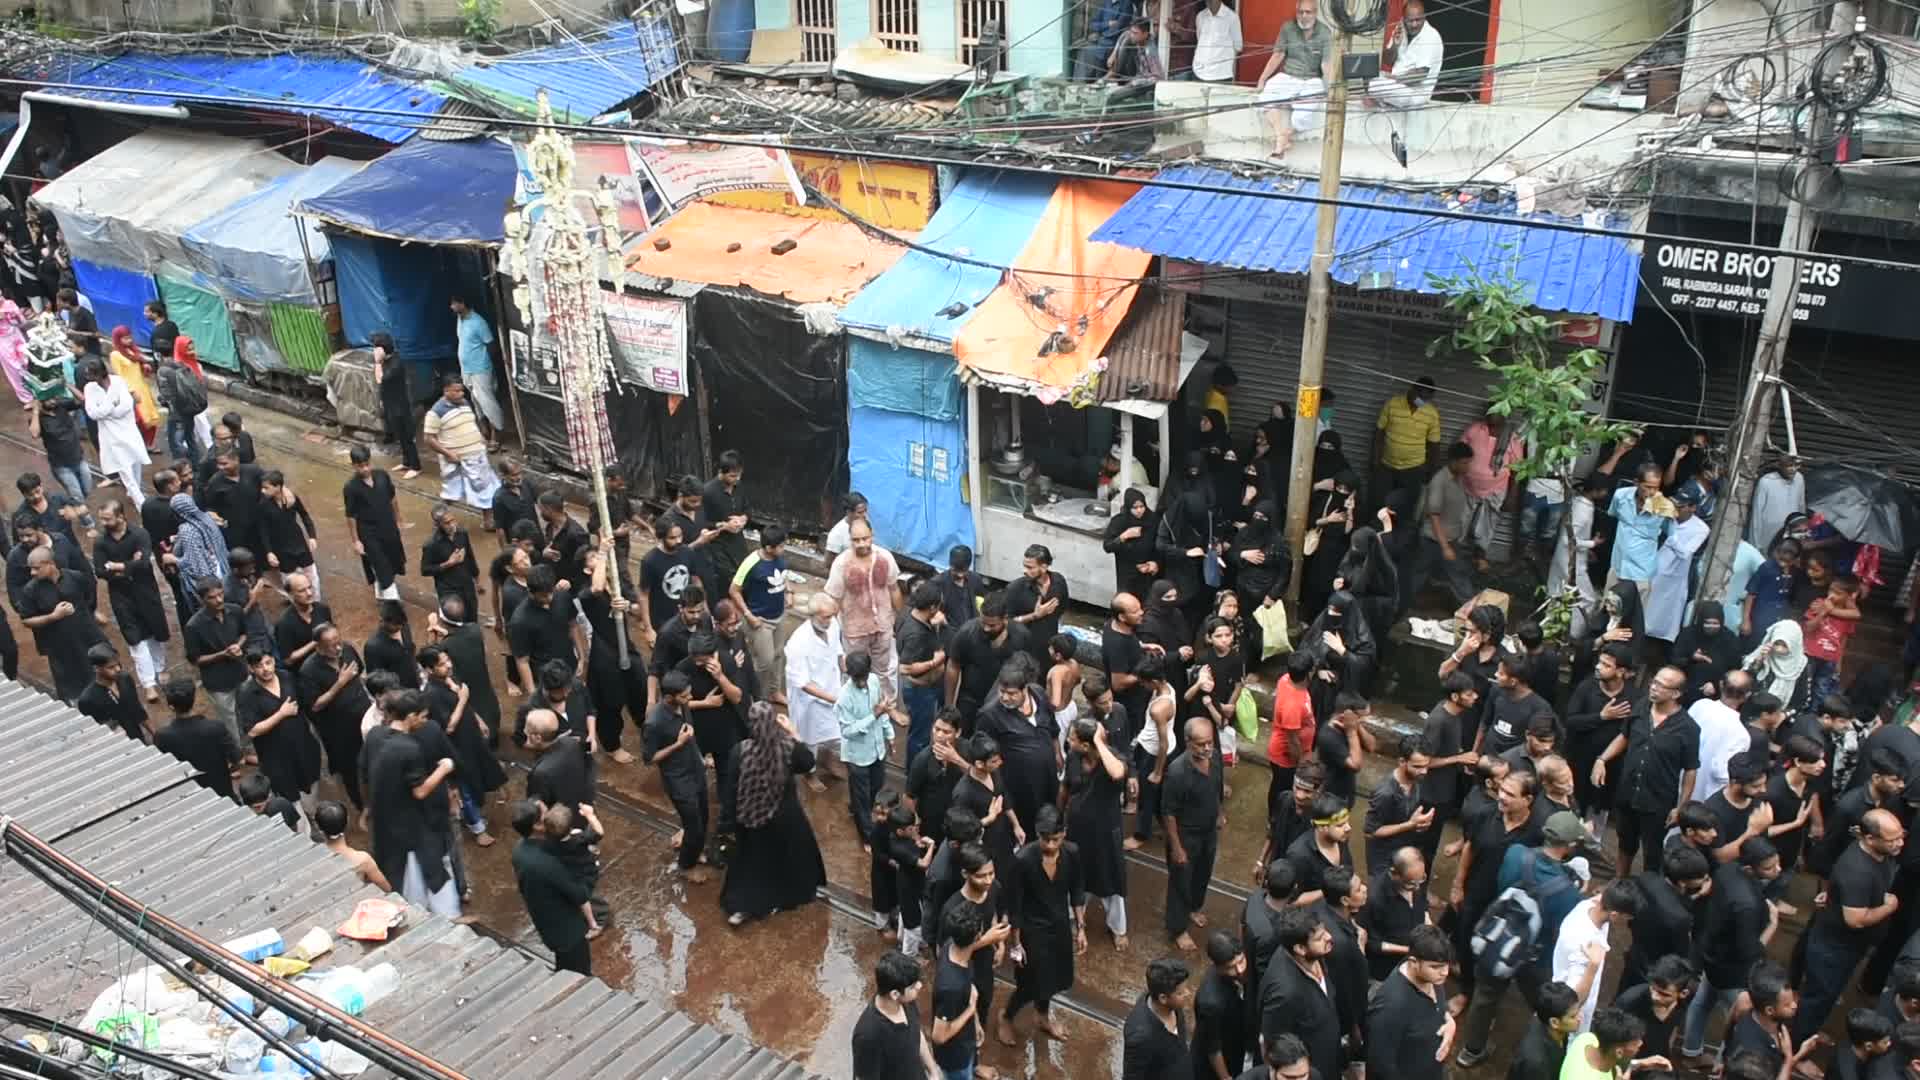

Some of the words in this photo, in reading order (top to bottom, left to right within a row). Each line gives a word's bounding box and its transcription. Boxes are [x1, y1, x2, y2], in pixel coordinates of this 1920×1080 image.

[1657, 244, 1720, 272] OMER
[1723, 252, 1842, 287] BROERS
[1671, 293, 1690, 305] OFF
